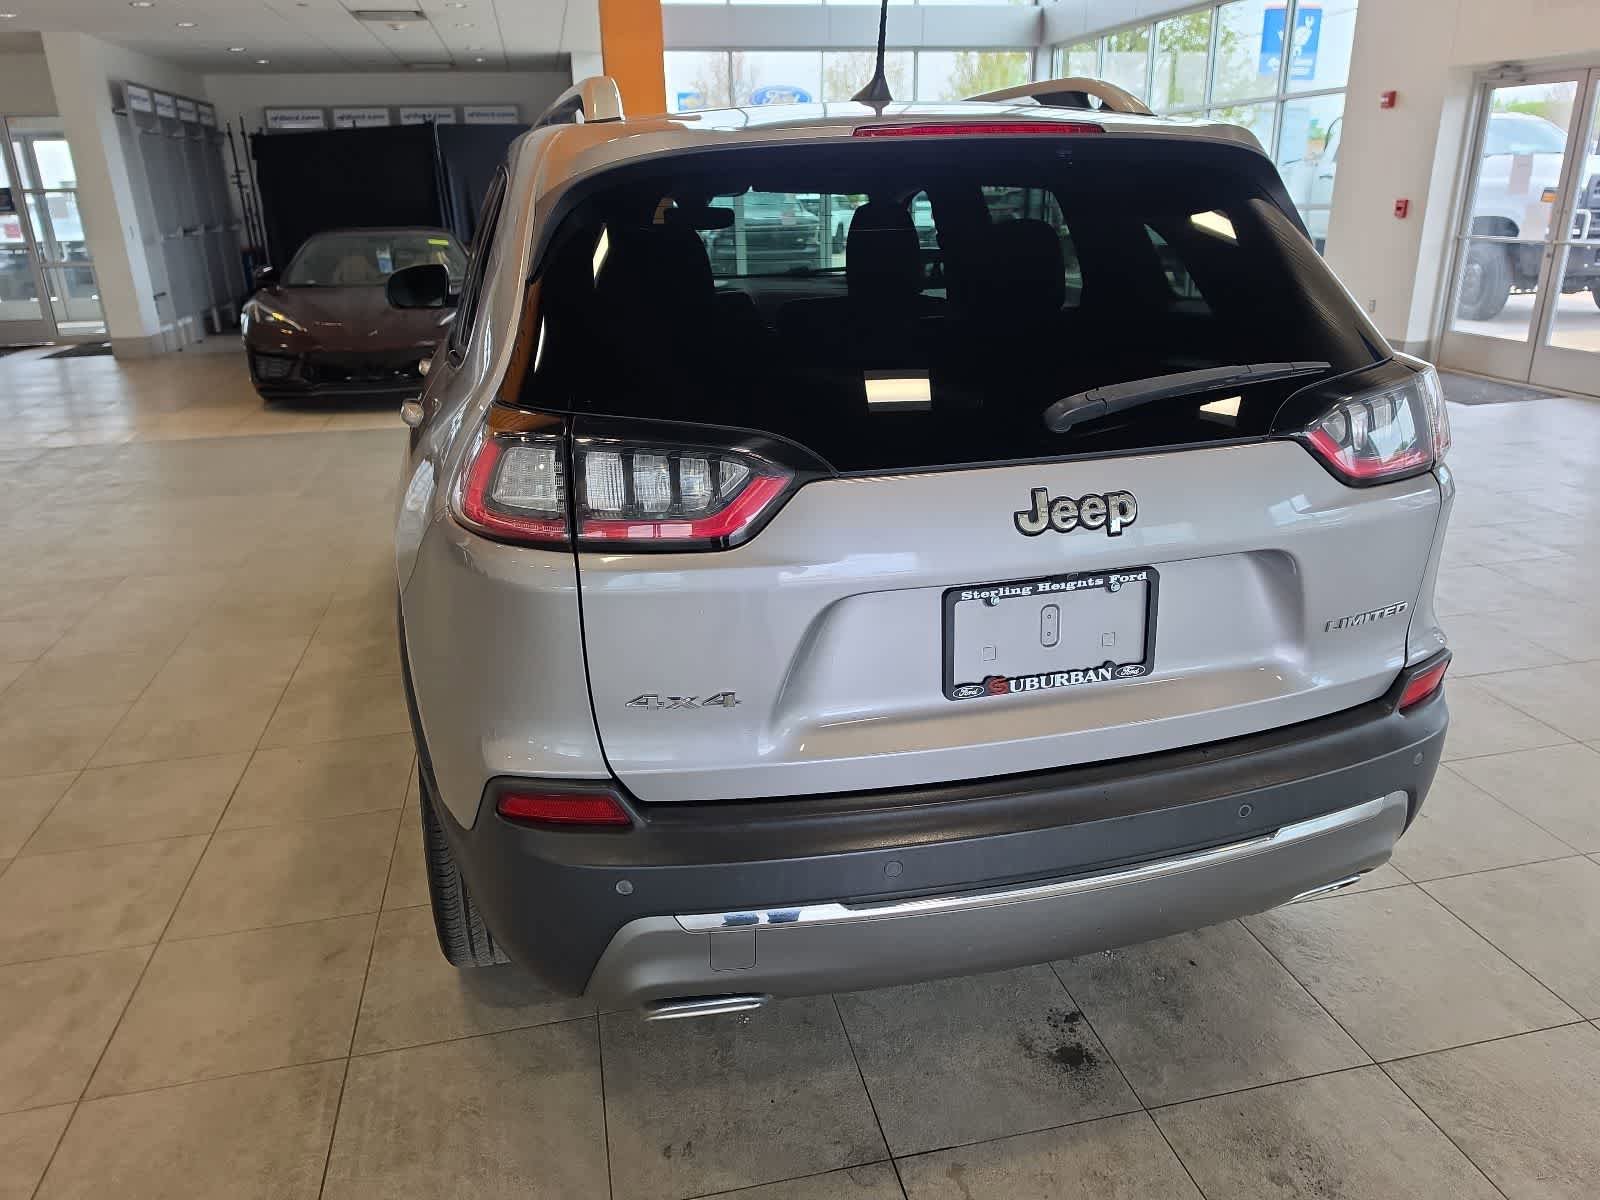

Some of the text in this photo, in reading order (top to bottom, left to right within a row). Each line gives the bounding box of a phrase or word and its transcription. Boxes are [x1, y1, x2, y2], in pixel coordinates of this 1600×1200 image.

[1014, 487, 1138, 537] Jeep
[961, 571, 1148, 601] Sterling Heights Ford
[1324, 600, 1408, 632] LIMITED
[988, 668, 1113, 695] SUBURBAN
